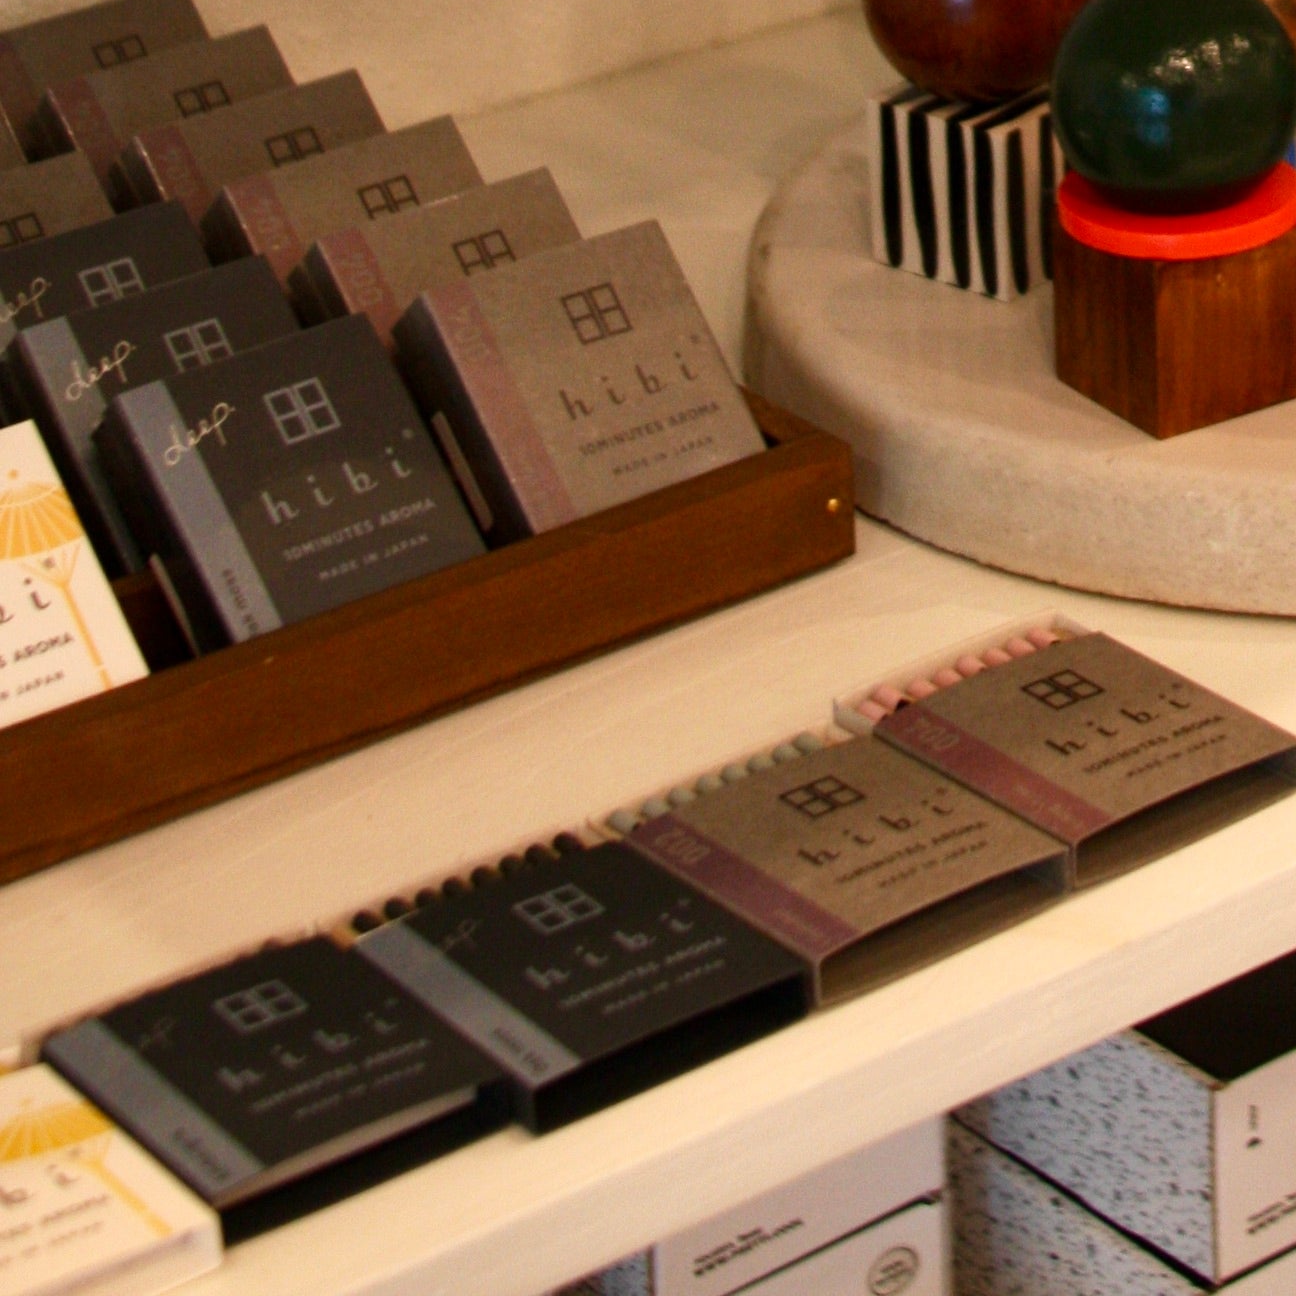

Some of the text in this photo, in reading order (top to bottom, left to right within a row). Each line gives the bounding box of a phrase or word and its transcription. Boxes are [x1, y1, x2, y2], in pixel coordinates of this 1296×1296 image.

[559, 351, 699, 421] hibi
[164, 402, 236, 466] deep
[668, 400, 721, 431] AROMA
[261, 446, 412, 526] hibi
[379, 498, 437, 527] AROMA
[318, 558, 360, 581] MADE
[384, 533, 430, 558] JAPAN
[14, 631, 73, 662] AROMA
[1046, 690, 1191, 756] hibi
